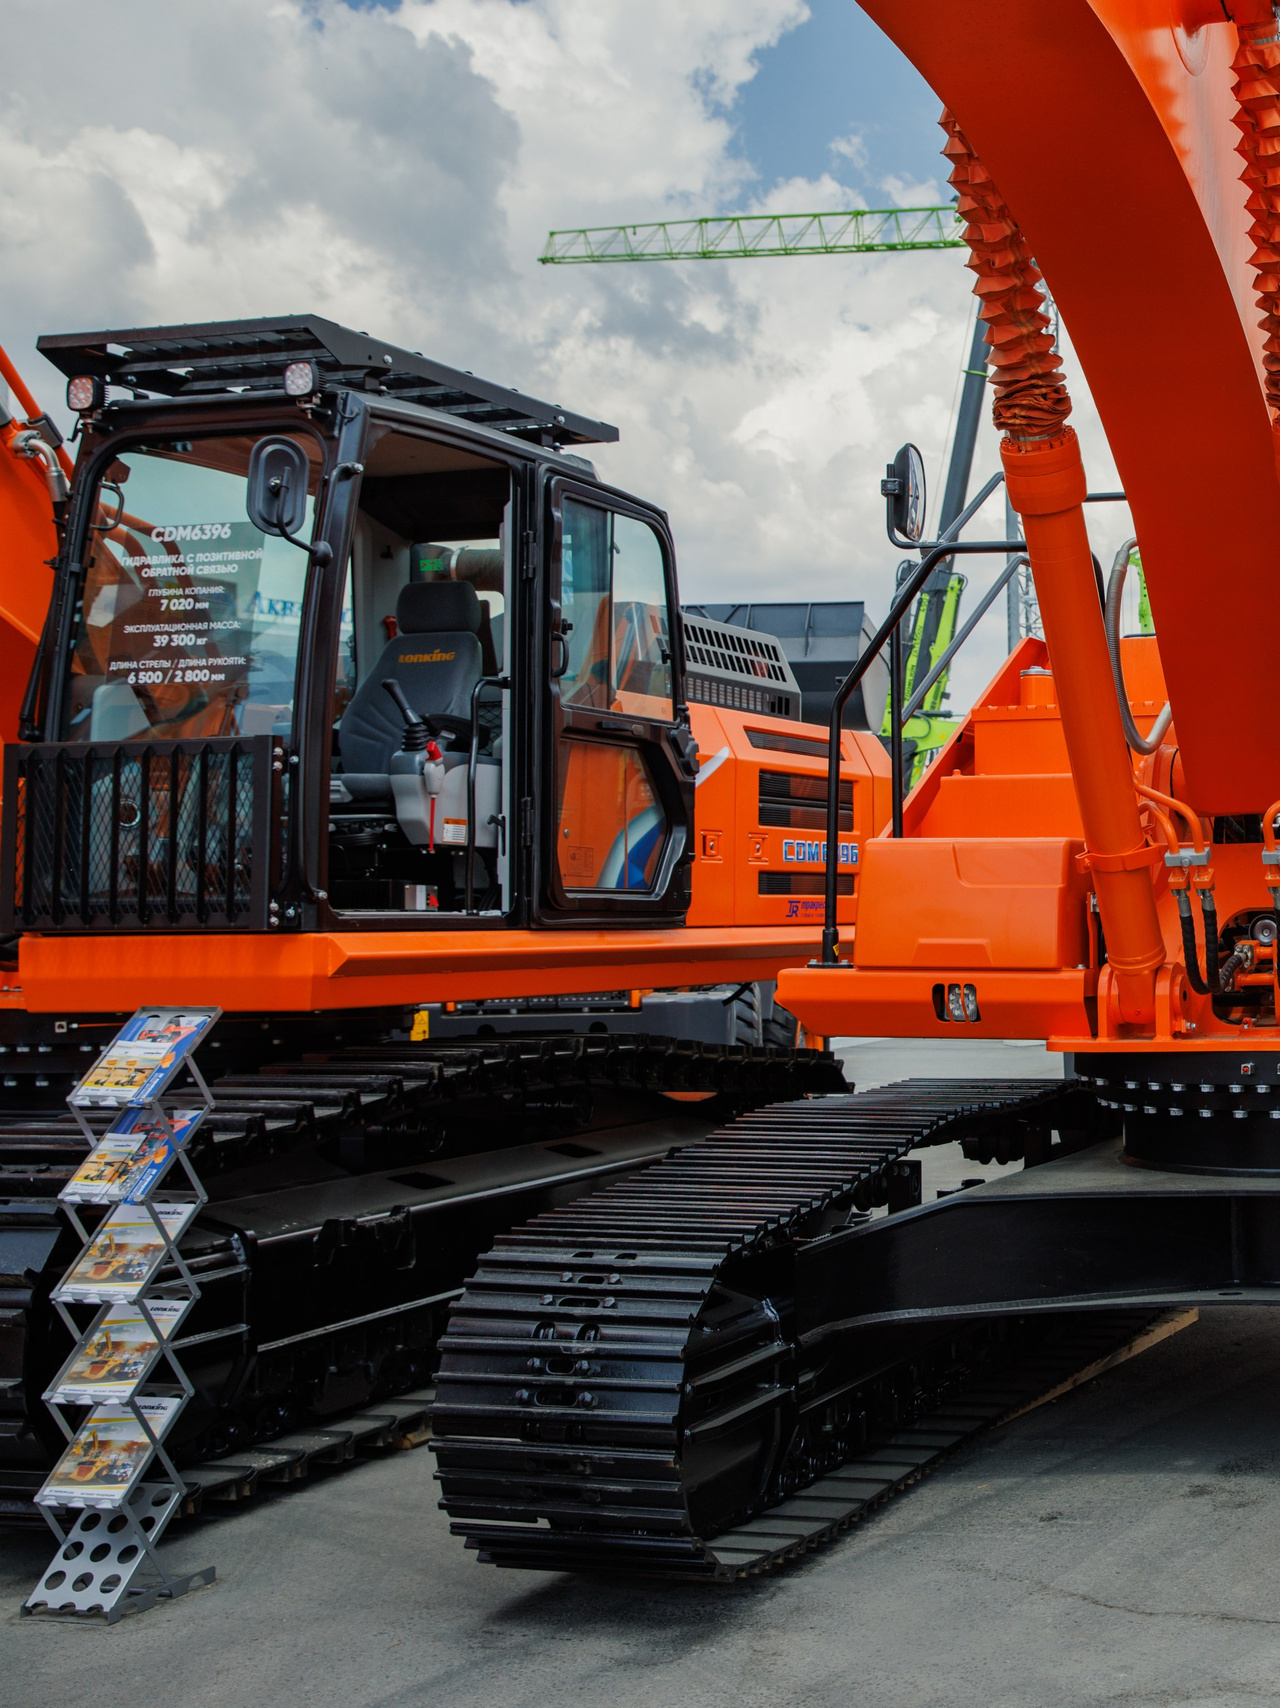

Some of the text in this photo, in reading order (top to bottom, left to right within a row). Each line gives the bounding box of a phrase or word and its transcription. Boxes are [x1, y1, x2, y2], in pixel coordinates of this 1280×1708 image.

[151, 523, 232, 543] CDM6396
[121, 548, 264, 567] ГИДРАВЛИКА С ПОЗИТИВНОЙ
[141, 563, 239, 578] ОБРАТНОЙ СВЯЗЬЮ
[148, 585, 226, 597] ГЛУБИНА КОПАНИЯ:
[160, 599, 169, 611] 7
[170, 598, 194, 611] 020
[195, 601, 210, 610] мм
[123, 620, 242, 634] ЭКСПЛУАТАЦИОННАЯ МАССА:
[153, 633, 208, 647] 39 300 кг
[109, 660, 138, 671] ДЛИНА
[138, 660, 171, 669] СТРЕЛЫ
[178, 658, 207, 668] ДЛИНА
[208, 656, 247, 667] РУКОЯТИ:
[127, 672, 137, 684] 6
[138, 671, 163, 684] 500
[174, 670, 184, 683] 2
[184, 669, 210, 682] 800
[211, 672, 226, 681] мм
[782, 839, 859, 865] CDM696
